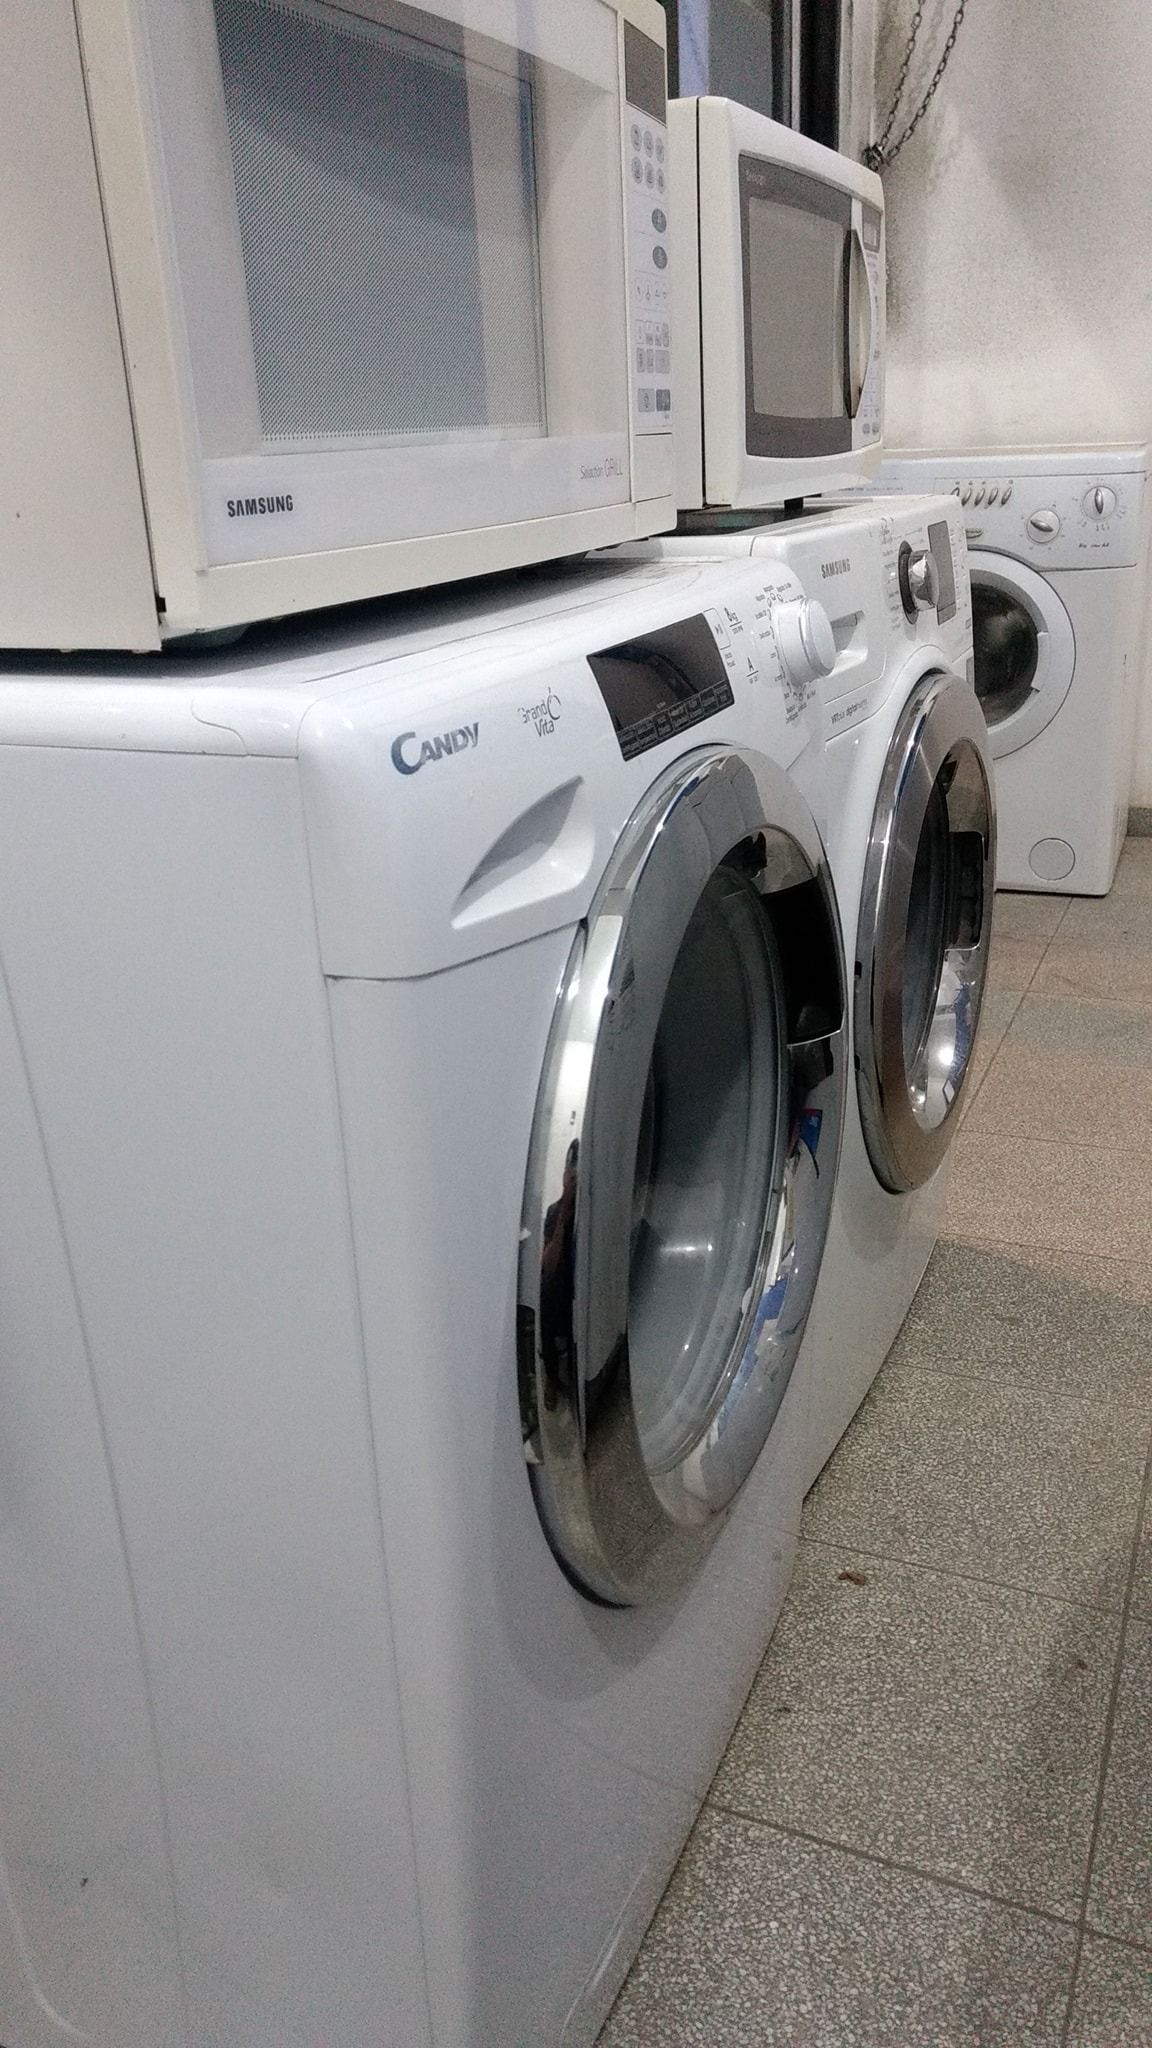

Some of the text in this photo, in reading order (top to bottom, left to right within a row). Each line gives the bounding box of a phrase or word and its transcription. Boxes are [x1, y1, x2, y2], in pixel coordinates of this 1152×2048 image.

[226, 494, 294, 518] SAMSUNG
[820, 558, 851, 579] SAMSUNG
[534, 718, 555, 738] Vita
[390, 721, 480, 776] CANDY
